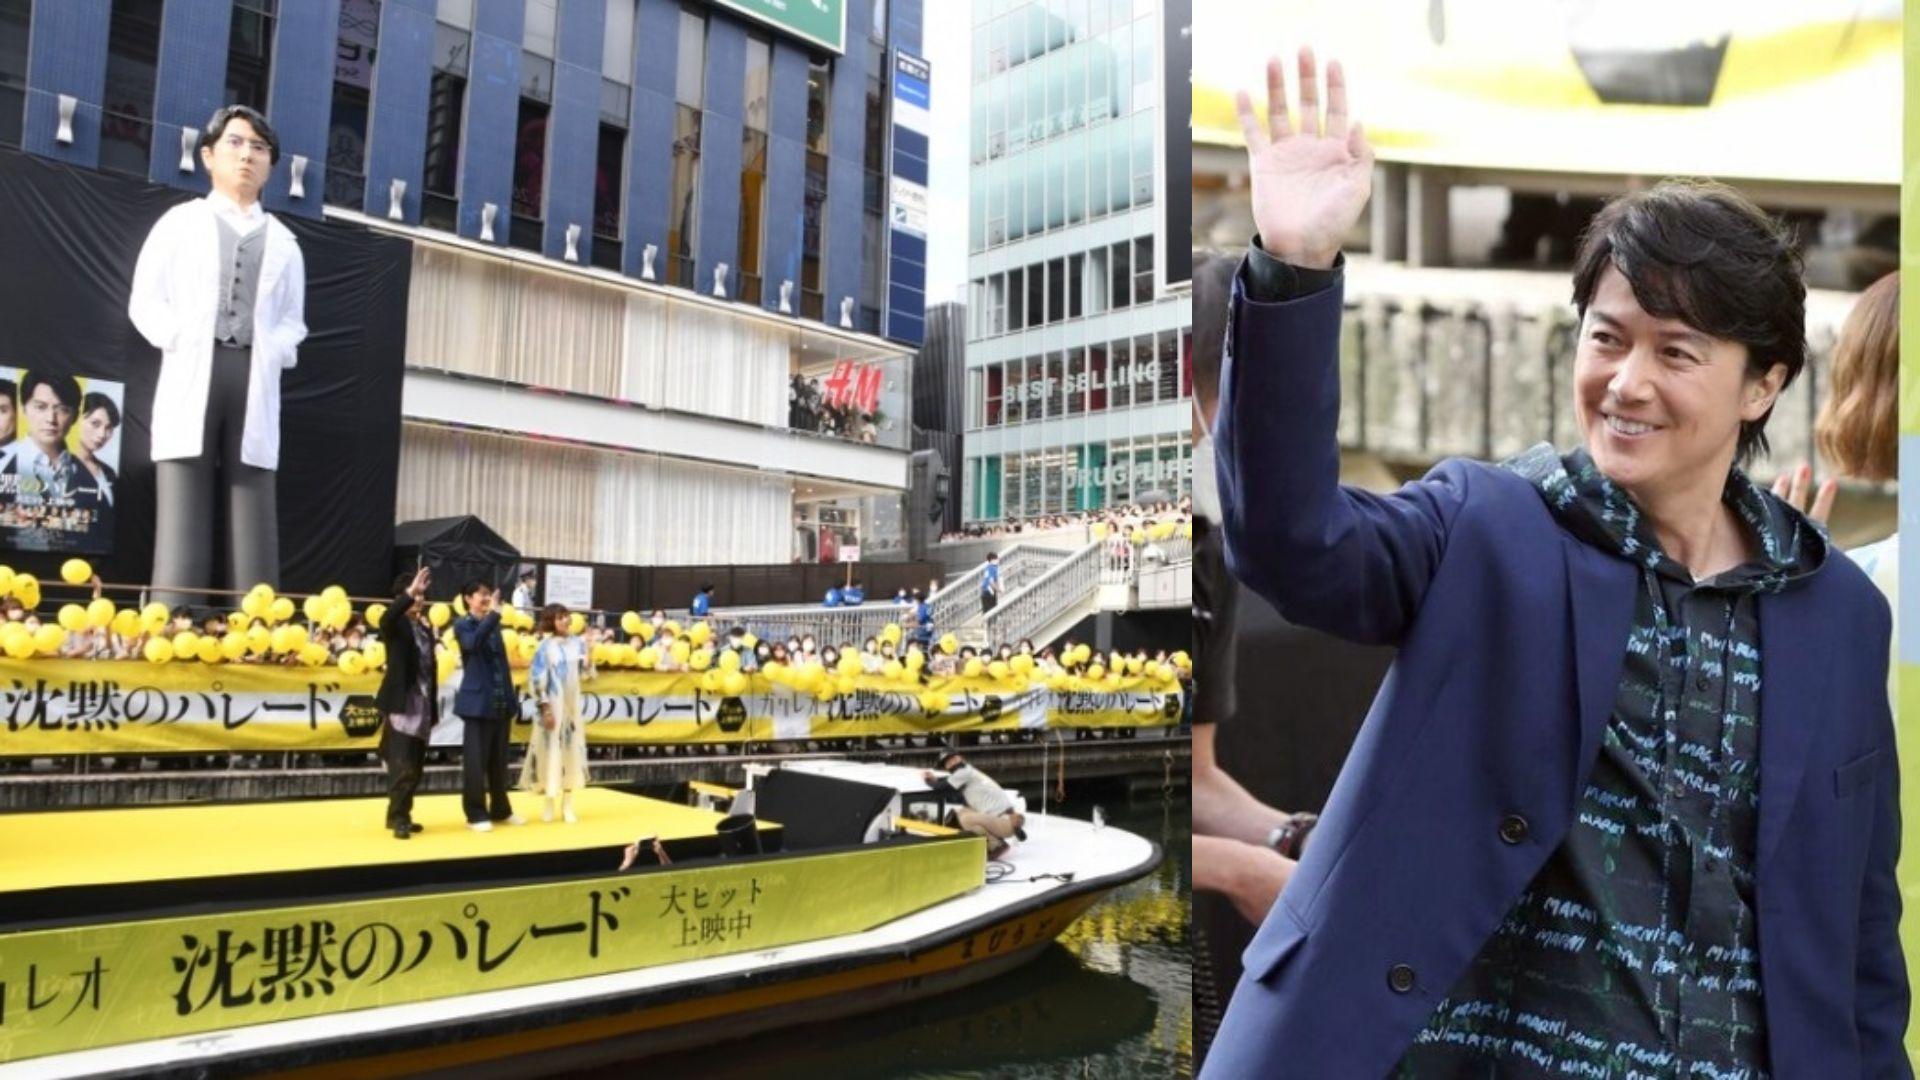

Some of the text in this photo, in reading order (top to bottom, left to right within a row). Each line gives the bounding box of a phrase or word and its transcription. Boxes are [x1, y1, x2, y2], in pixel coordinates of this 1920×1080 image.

[1004, 359, 1162, 404] BEST SELLING
[5, 679, 341, 732] 沈黙のパレード
[659, 878, 763, 920] 大ヒット
[171, 885, 632, 1016] 沈黙のパレード
[672, 910, 753, 950] 上映中
